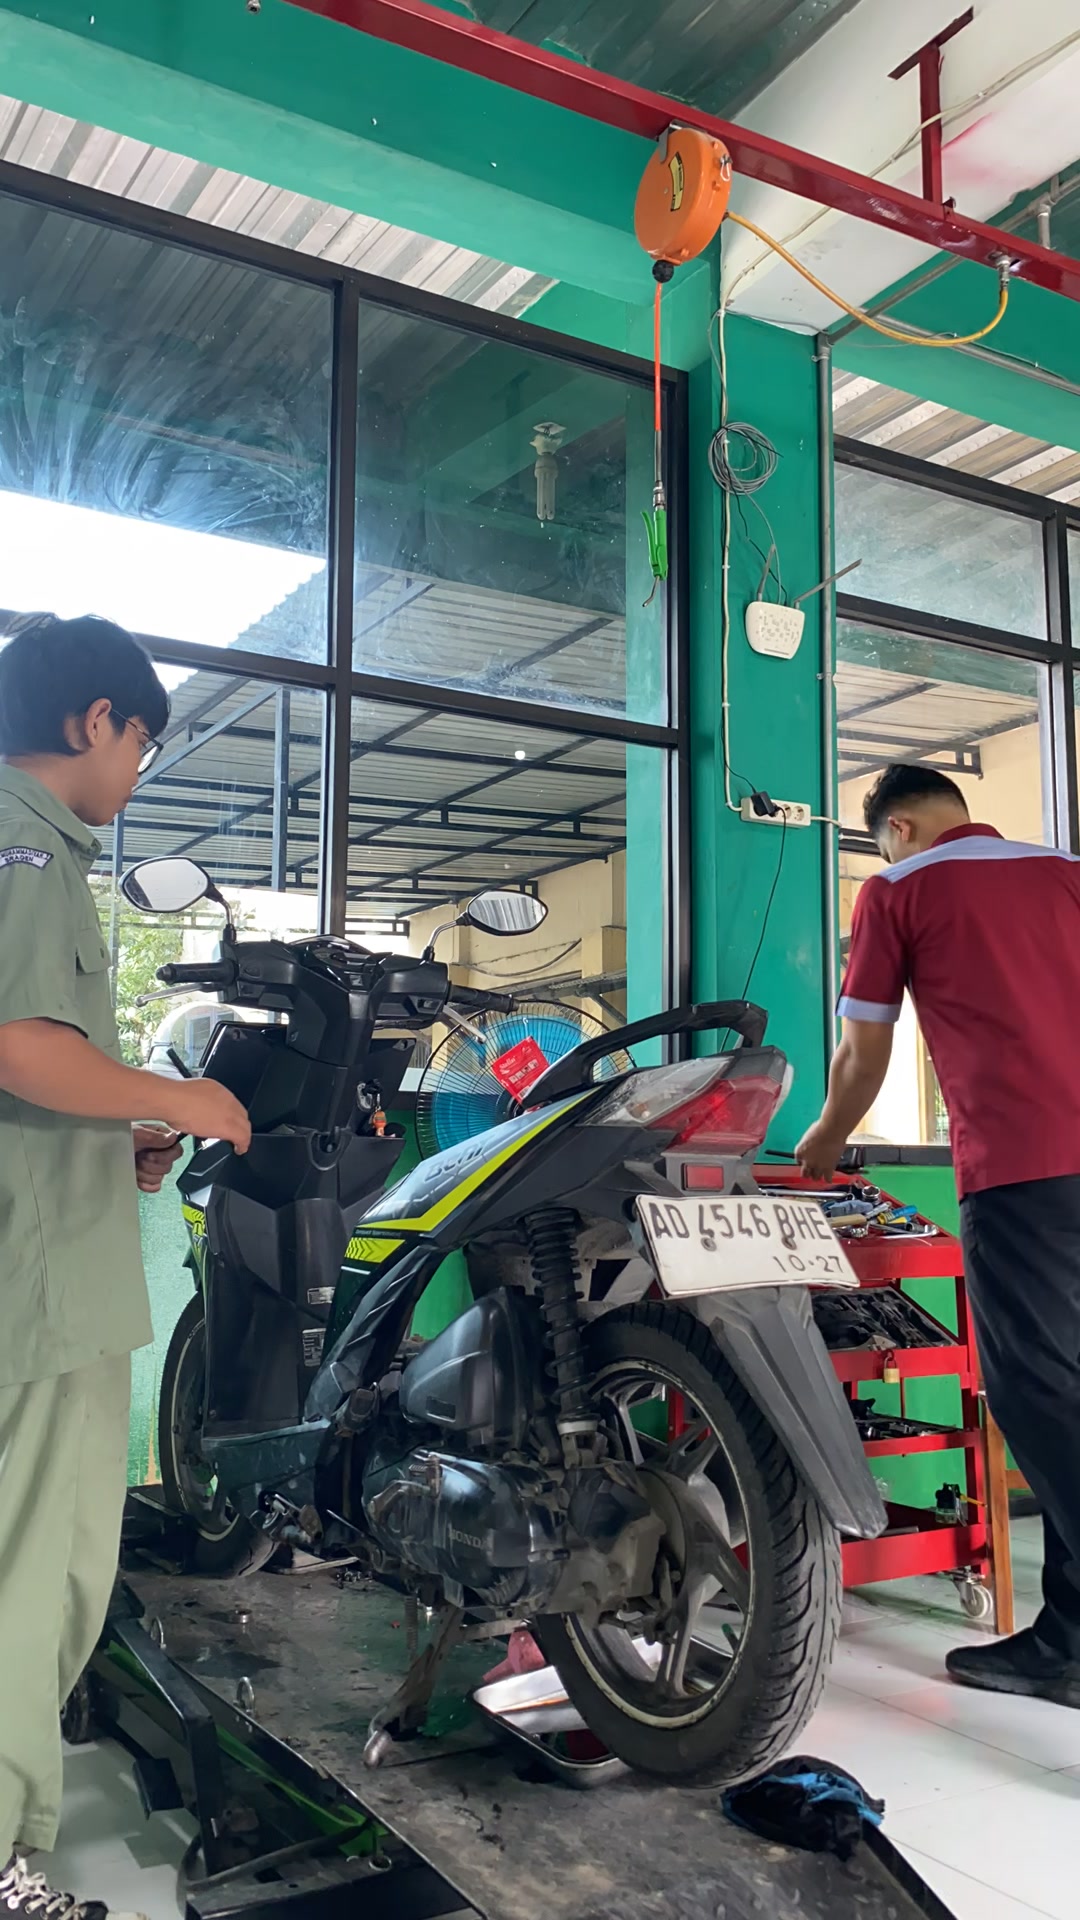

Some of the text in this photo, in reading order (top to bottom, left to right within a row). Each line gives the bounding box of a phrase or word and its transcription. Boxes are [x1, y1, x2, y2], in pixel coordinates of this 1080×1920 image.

[649, 1202, 832, 1241] AD 4546 BHE
